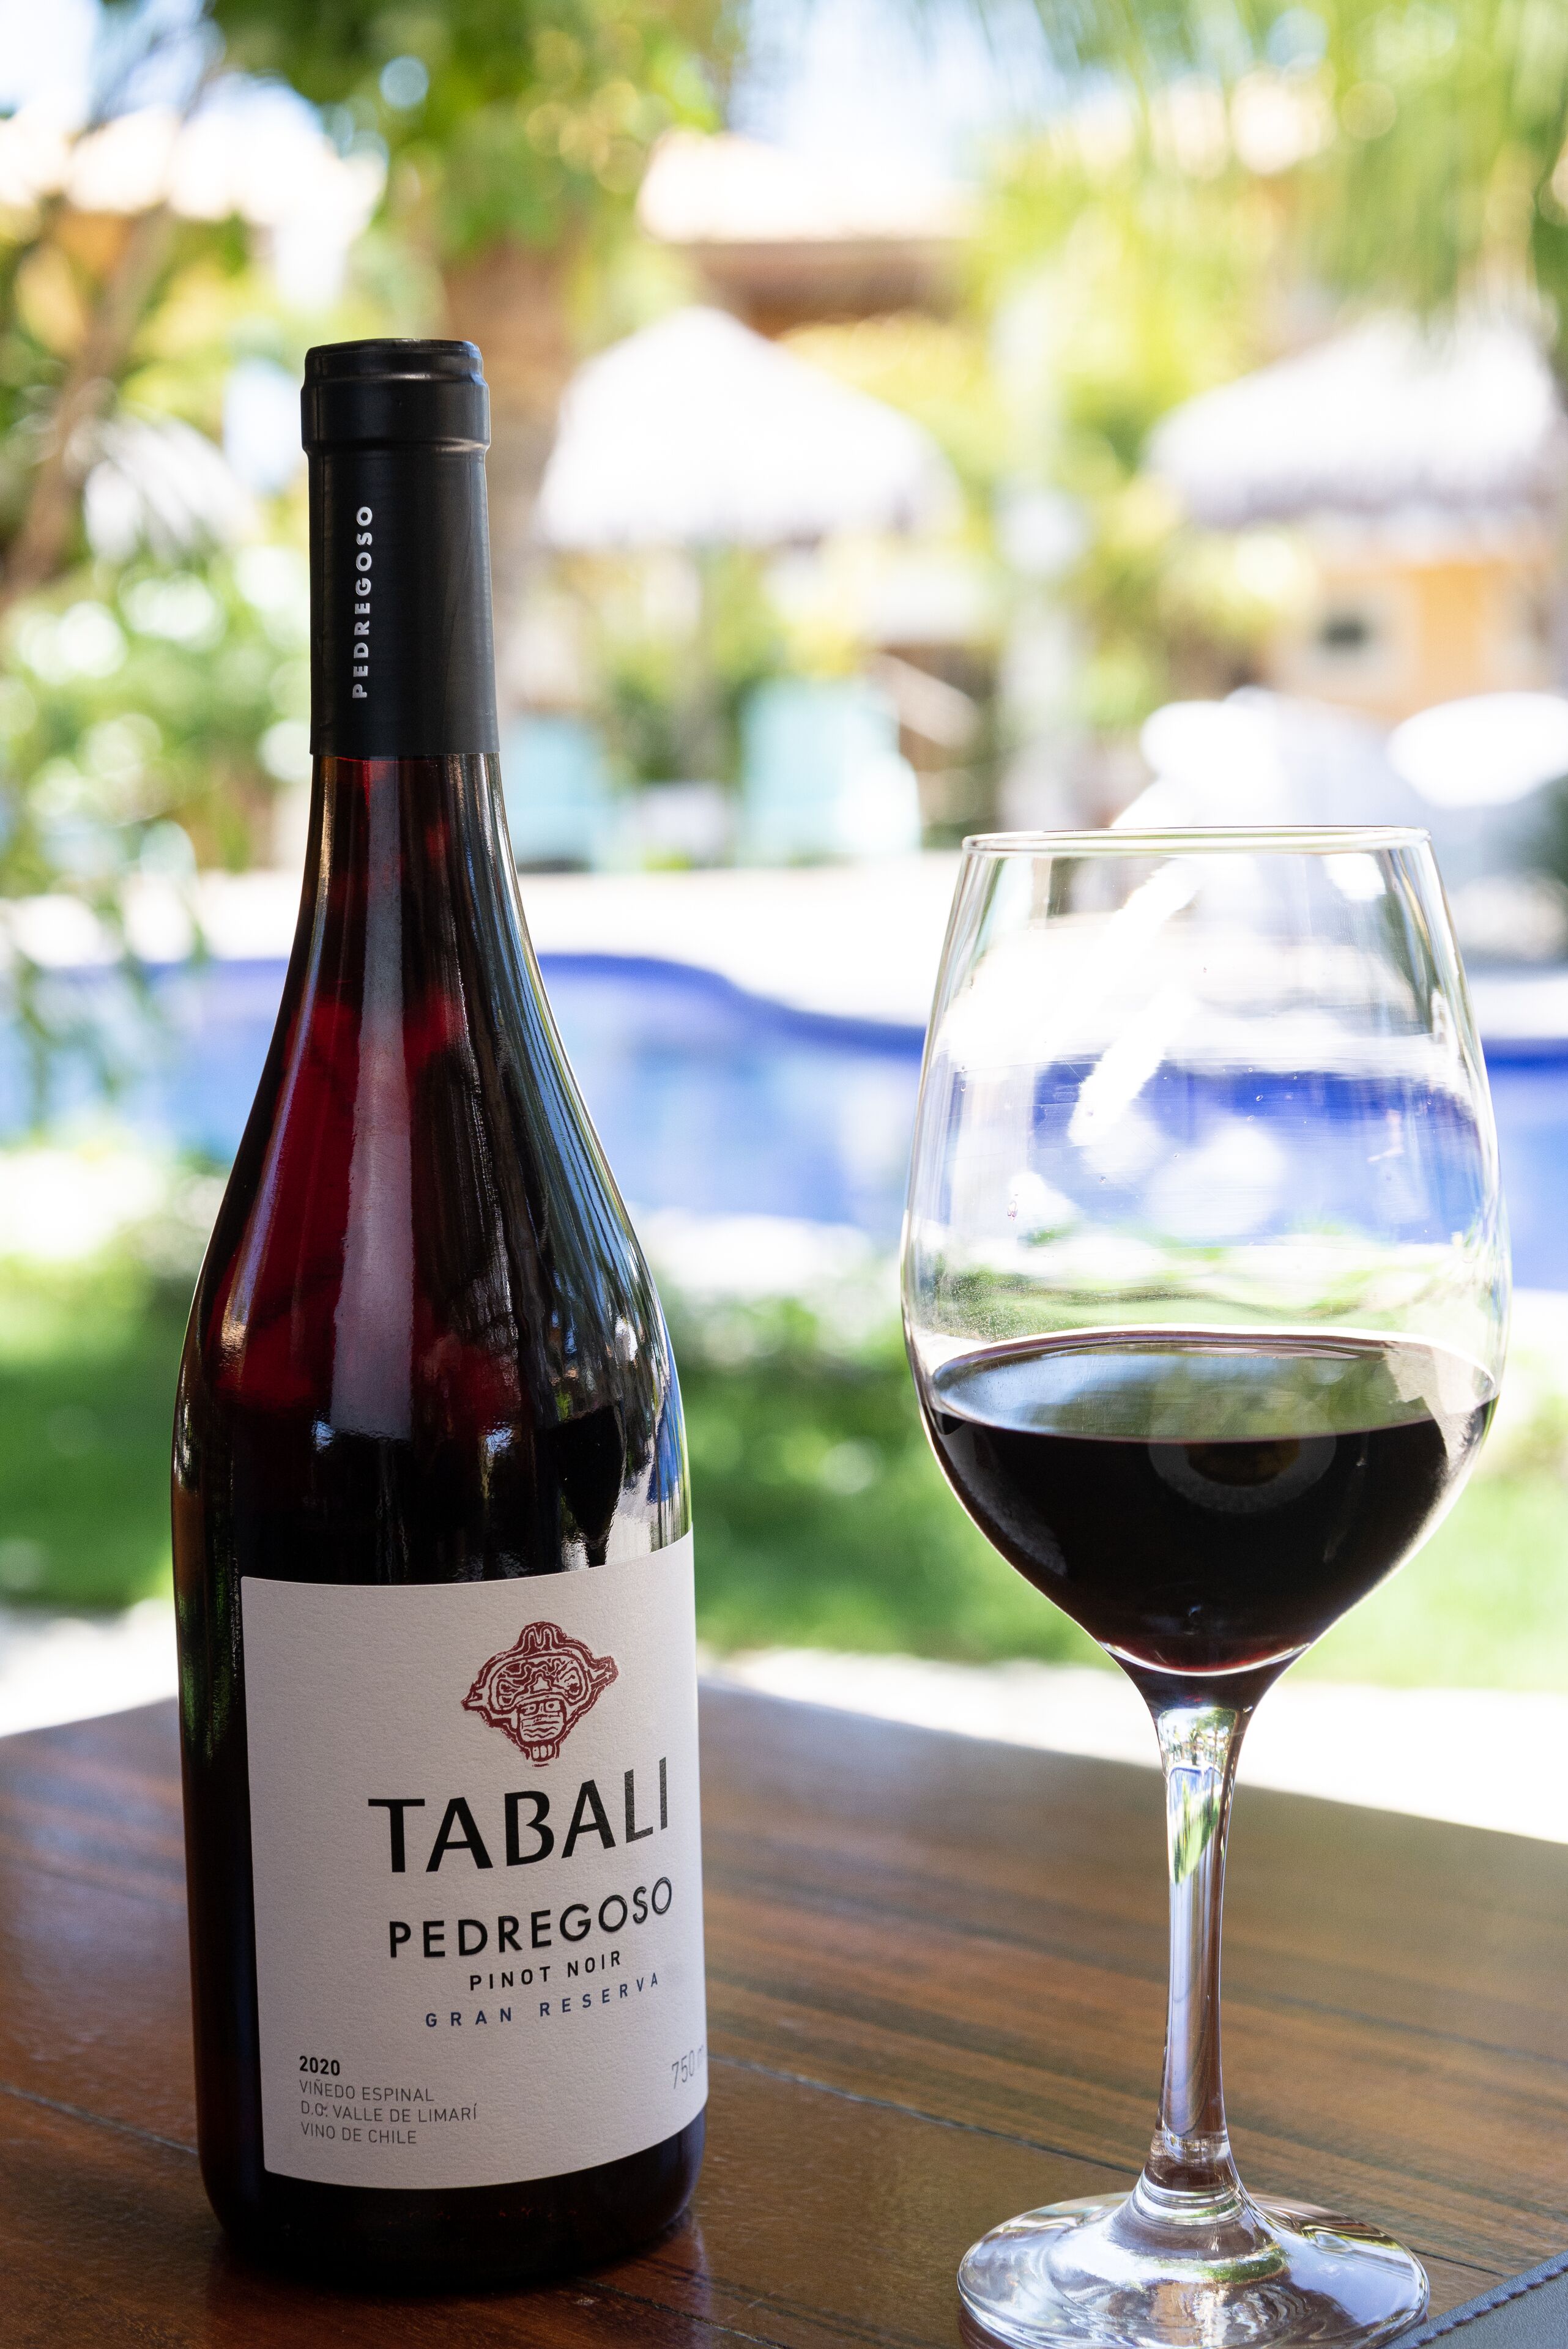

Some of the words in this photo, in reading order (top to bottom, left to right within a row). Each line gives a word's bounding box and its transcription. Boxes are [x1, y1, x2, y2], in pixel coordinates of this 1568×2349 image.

[352, 507, 373, 698] PEDREGOSO
[368, 1757, 668, 1872] TABALI
[389, 1877, 672, 1958] PEDREGOSO
[469, 1966, 551, 1991] PINOT
[567, 1950, 621, 1978] NOIR
[425, 2007, 512, 2028] GRAN
[539, 1973, 658, 2017] RESERVA
[299, 2055, 340, 2076] 2020
[299, 2079, 355, 2099] VIÑEDO
[362, 2087, 434, 2102] ESPINAL
[301, 2121, 336, 2139] VINO
[342, 2128, 362, 2142] DE
[368, 2129, 417, 2144] CHILE
[332, 2105, 382, 2121] VALLE
[390, 2109, 411, 2123] DE
[418, 2103, 478, 2123] LIMARÍ
